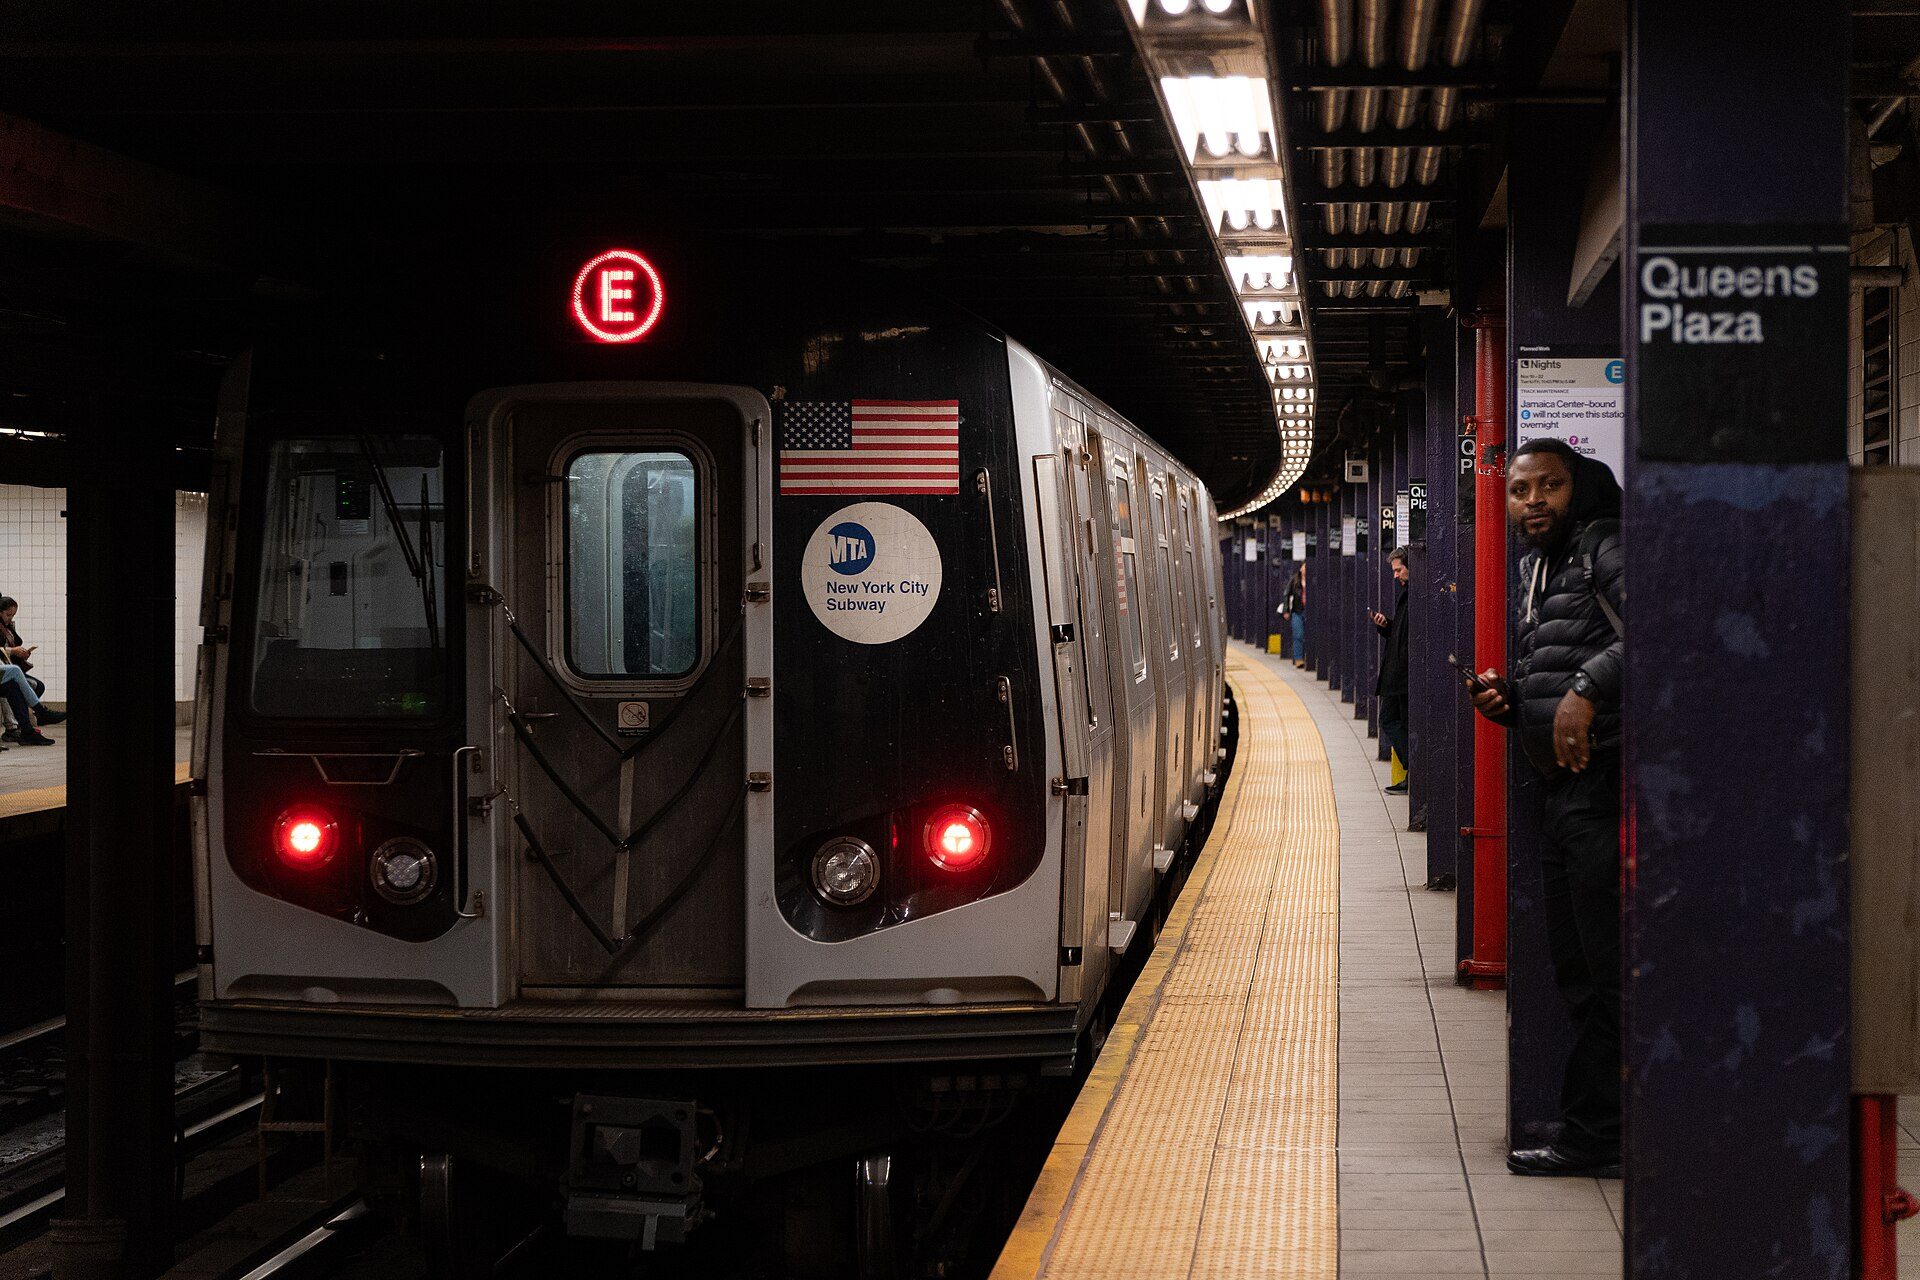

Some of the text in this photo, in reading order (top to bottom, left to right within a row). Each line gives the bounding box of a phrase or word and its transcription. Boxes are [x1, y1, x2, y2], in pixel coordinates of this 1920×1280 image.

[1640, 256, 1819, 299] Queens
[601, 270, 635, 322] E
[1640, 303, 1764, 344] Plaza
[1531, 360, 1561, 370] Nights
[1611, 365, 1623, 379] E
[1520, 400, 1555, 408] Jamaica
[1533, 410, 1546, 418] will
[1586, 410, 1600, 418] this
[1520, 421, 1559, 430] overnight
[828, 534, 868, 565] MTA
[826, 581, 929, 597] New York City
[826, 598, 886, 613] Subway
